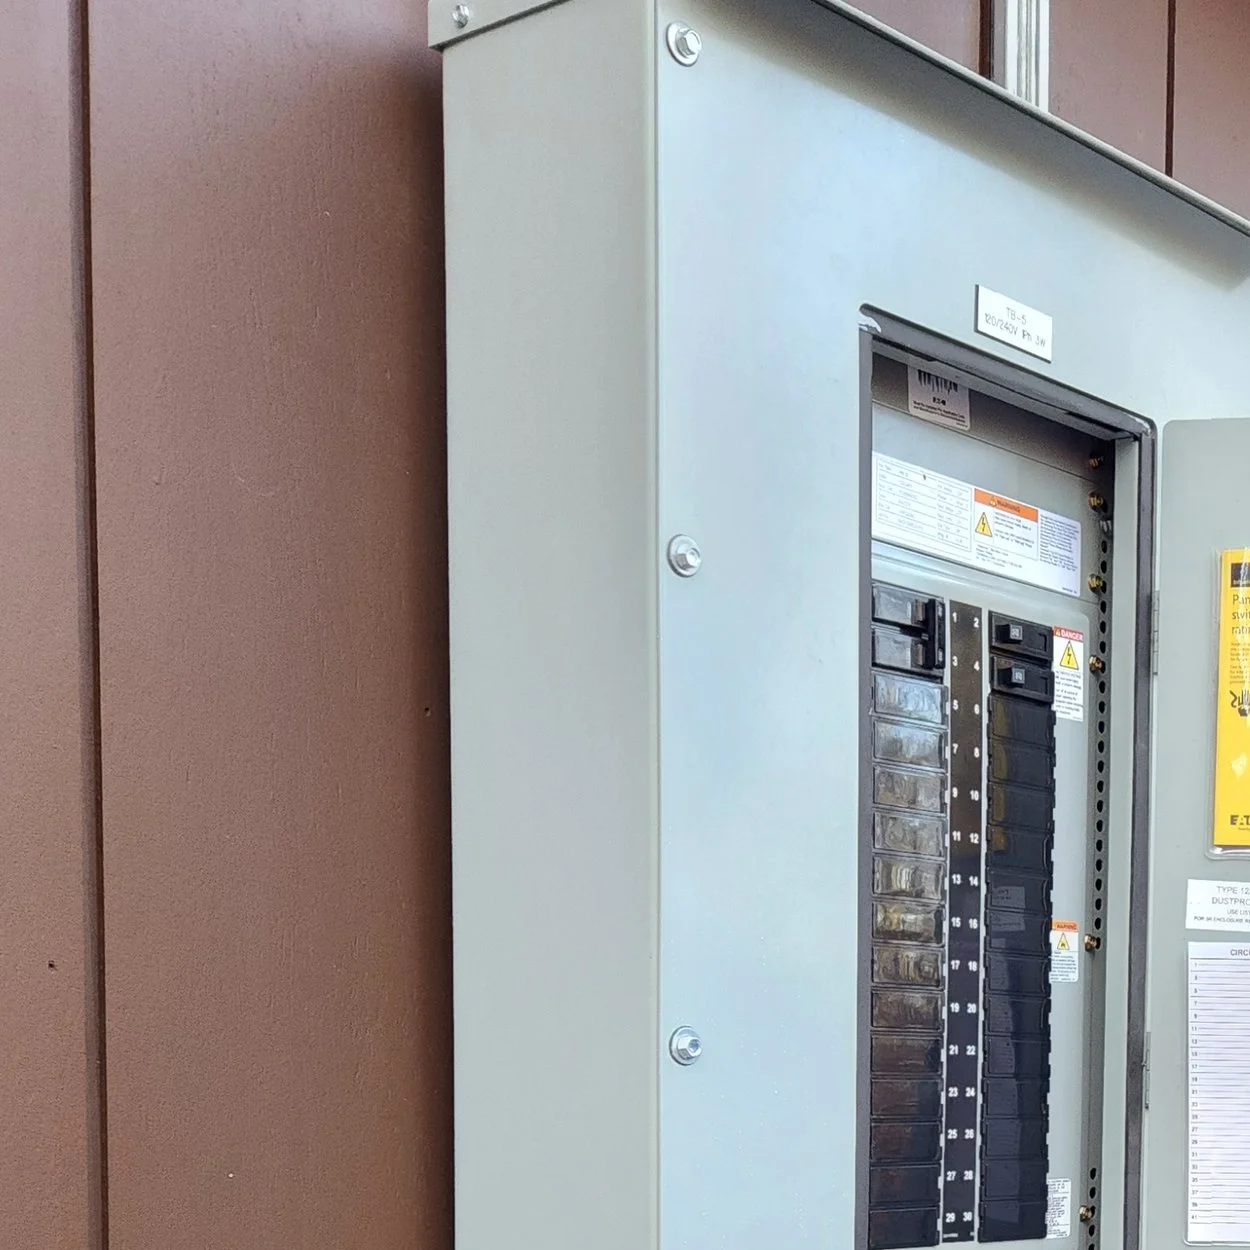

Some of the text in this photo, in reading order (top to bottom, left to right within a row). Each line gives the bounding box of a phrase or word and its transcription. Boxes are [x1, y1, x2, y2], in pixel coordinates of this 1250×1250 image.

[1006, 306, 1027, 325] TB-5
[952, 612, 958, 623] 1
[973, 617, 980, 628] 2
[1061, 627, 1083, 641] DANGER
[952, 656, 959, 667] 3
[974, 661, 981, 671] 4
[952, 700, 959, 710] 5
[974, 704, 980, 714] 6
[952, 744, 959, 754] 7
[973, 747, 980, 757] 8
[952, 787, 959, 797] 9
[969, 790, 979, 801] 10
[952, 831, 961, 841] 11
[969, 833, 979, 844] 12
[952, 874, 962, 884] 13
[968, 876, 978, 886] 14
[1217, 886, 1238, 895] TYPE
[951, 917, 962, 927] 15
[968, 919, 978, 929] 16
[950, 960, 961, 970] 17
[967, 961, 977, 971] 18
[949, 1003, 960, 1012] 19
[966, 1003, 977, 1013] 20
[948, 1045, 959, 1055] 21
[966, 1045, 976, 1055] 22
[948, 1087, 959, 1097] 23
[965, 1087, 975, 1097] 24
[947, 1129, 958, 1139] 25
[964, 1129, 974, 1139] 26
[946, 1171, 957, 1181] 27
[963, 1170, 973, 1180] 28
[946, 1213, 956, 1222] 29
[963, 1212, 973, 1221] 30
